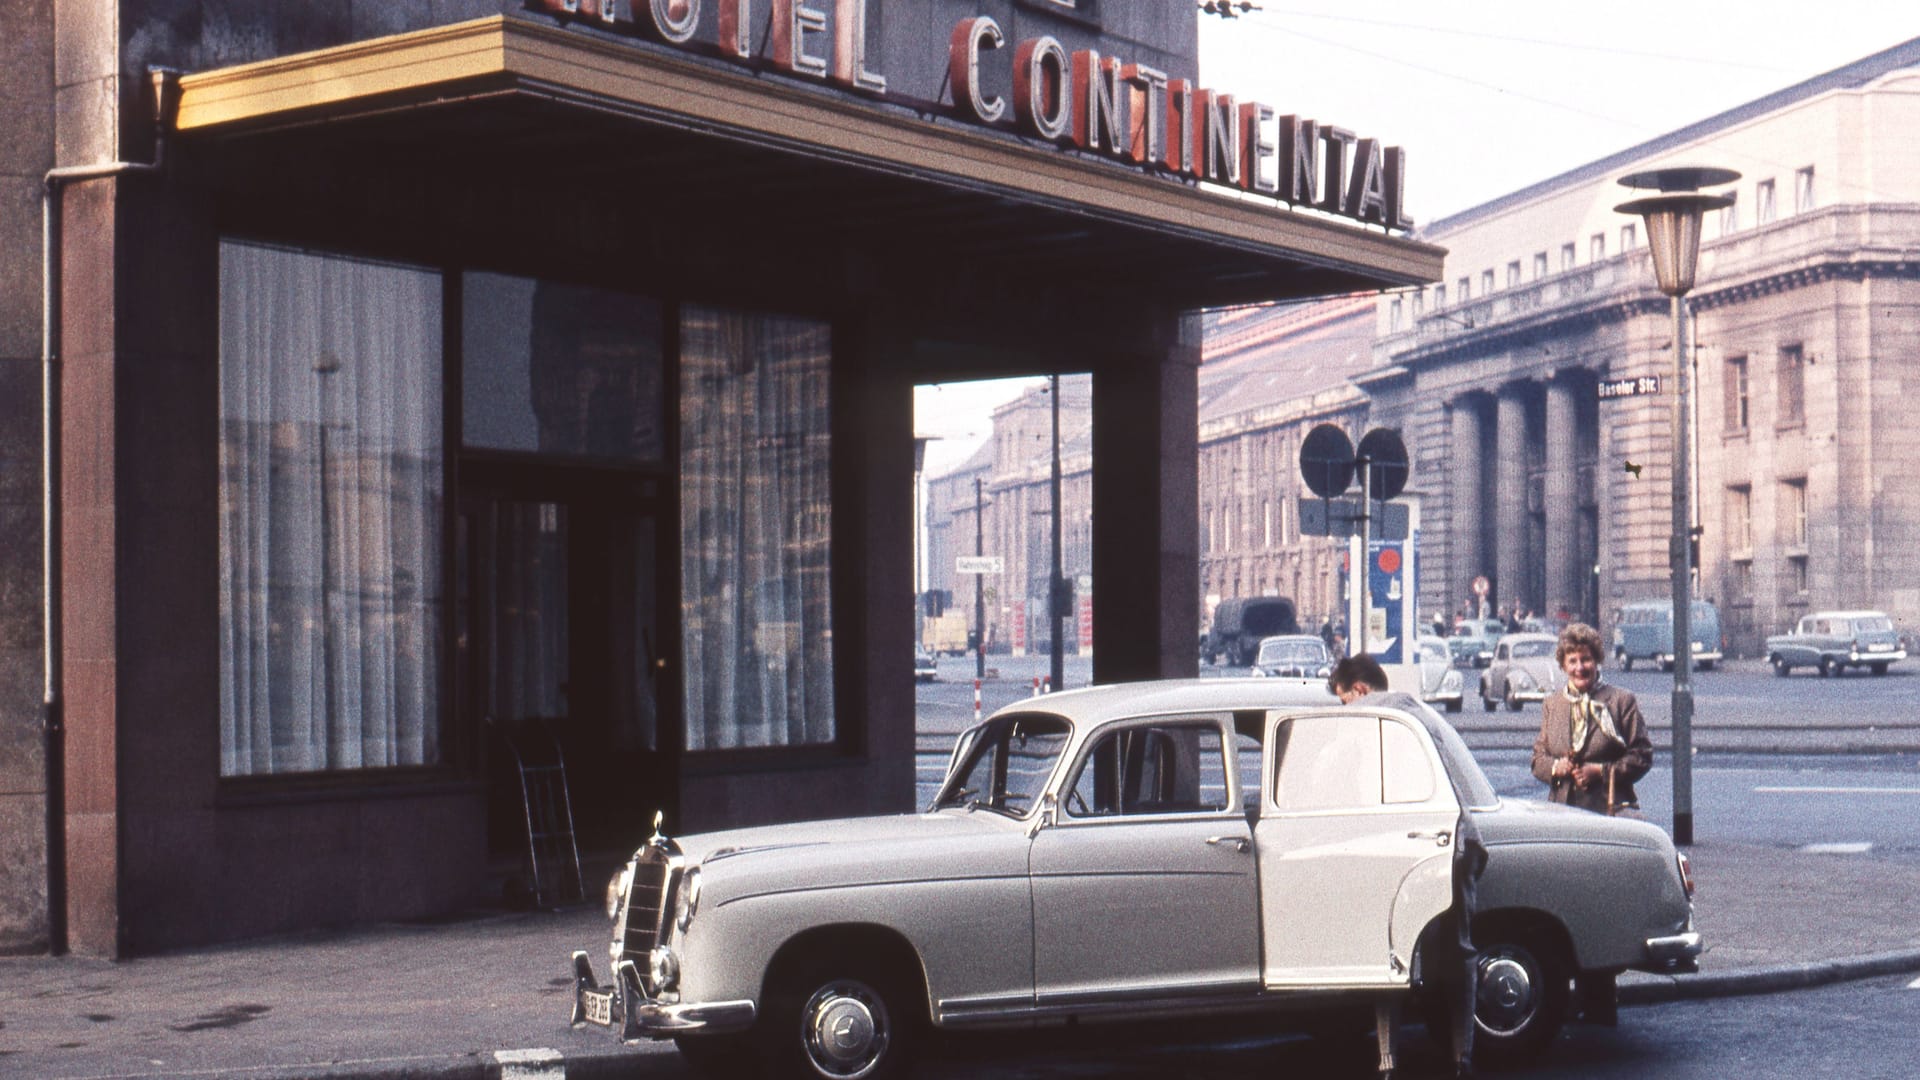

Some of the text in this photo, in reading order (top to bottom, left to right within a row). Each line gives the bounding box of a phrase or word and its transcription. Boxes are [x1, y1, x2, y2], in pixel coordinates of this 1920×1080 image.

[543, 0, 1415, 231] TEL CONTINENTAL
[1598, 377, 1657, 397] Baseler Str.
